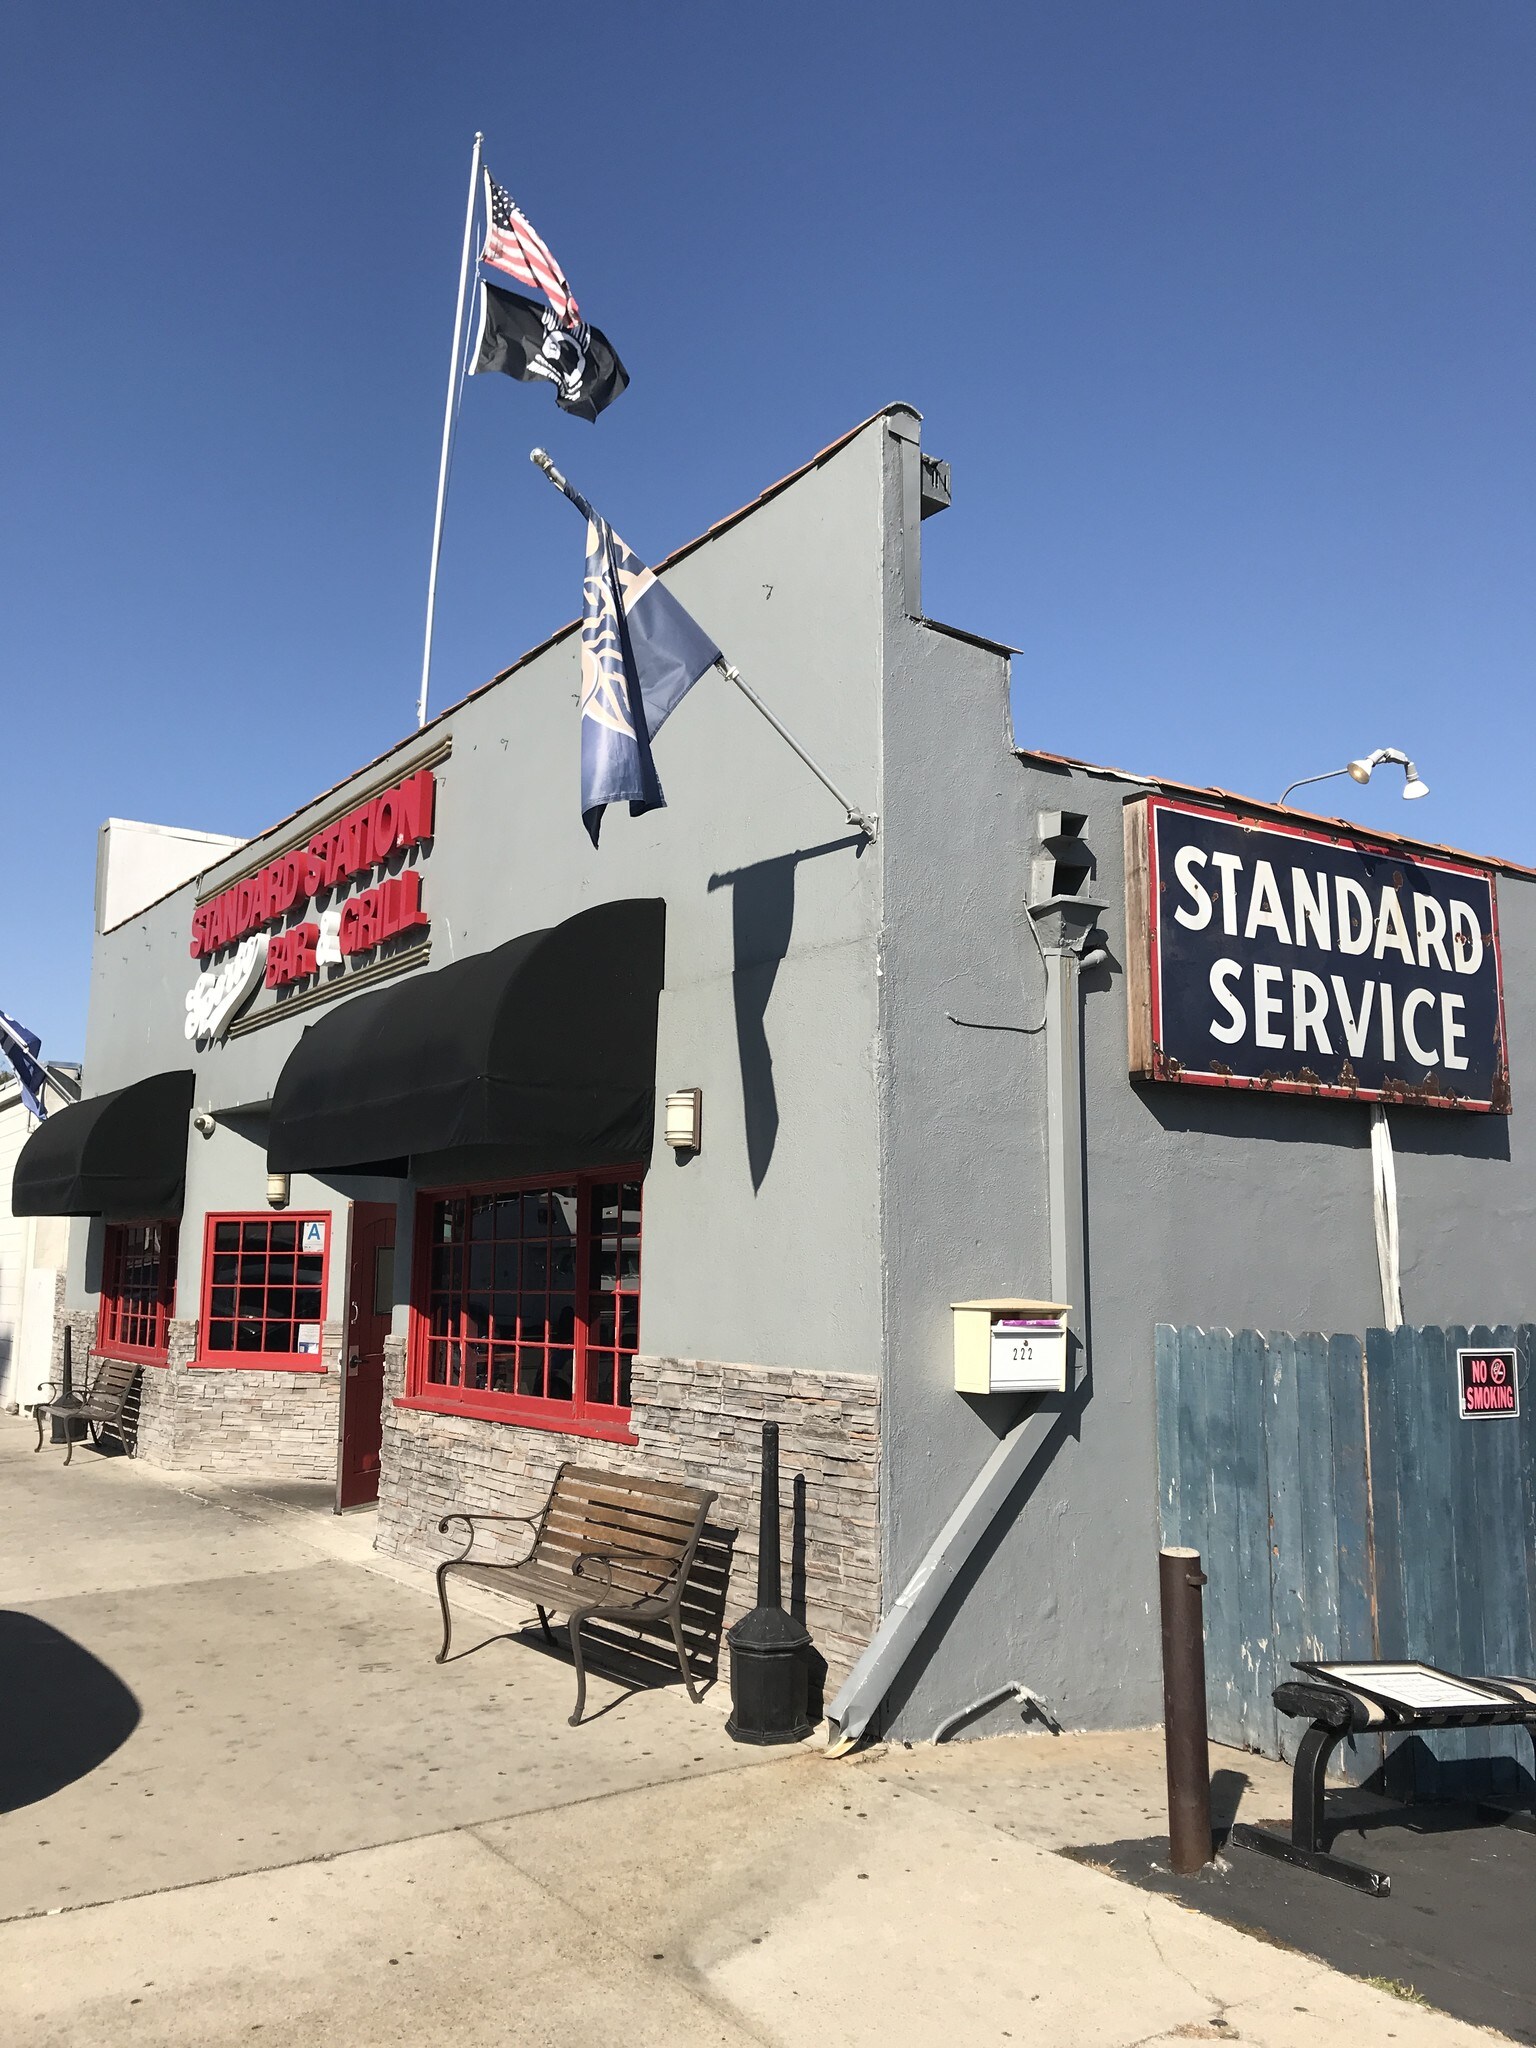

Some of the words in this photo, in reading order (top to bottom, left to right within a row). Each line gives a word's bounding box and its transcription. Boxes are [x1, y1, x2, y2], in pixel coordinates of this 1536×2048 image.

[190, 850, 308, 959] STANDARD
[304, 769, 433, 897] STATION
[265, 922, 319, 990] BAR
[339, 870, 427, 956] GRILL
[1173, 845, 1484, 975] STANDARD
[1208, 957, 1470, 1071] SERVICE
[307, 1223, 321, 1240] A
[1012, 1347, 1033, 1361] 222
[1471, 1360, 1488, 1384] NO
[1466, 1385, 1514, 1410] SMOKING
